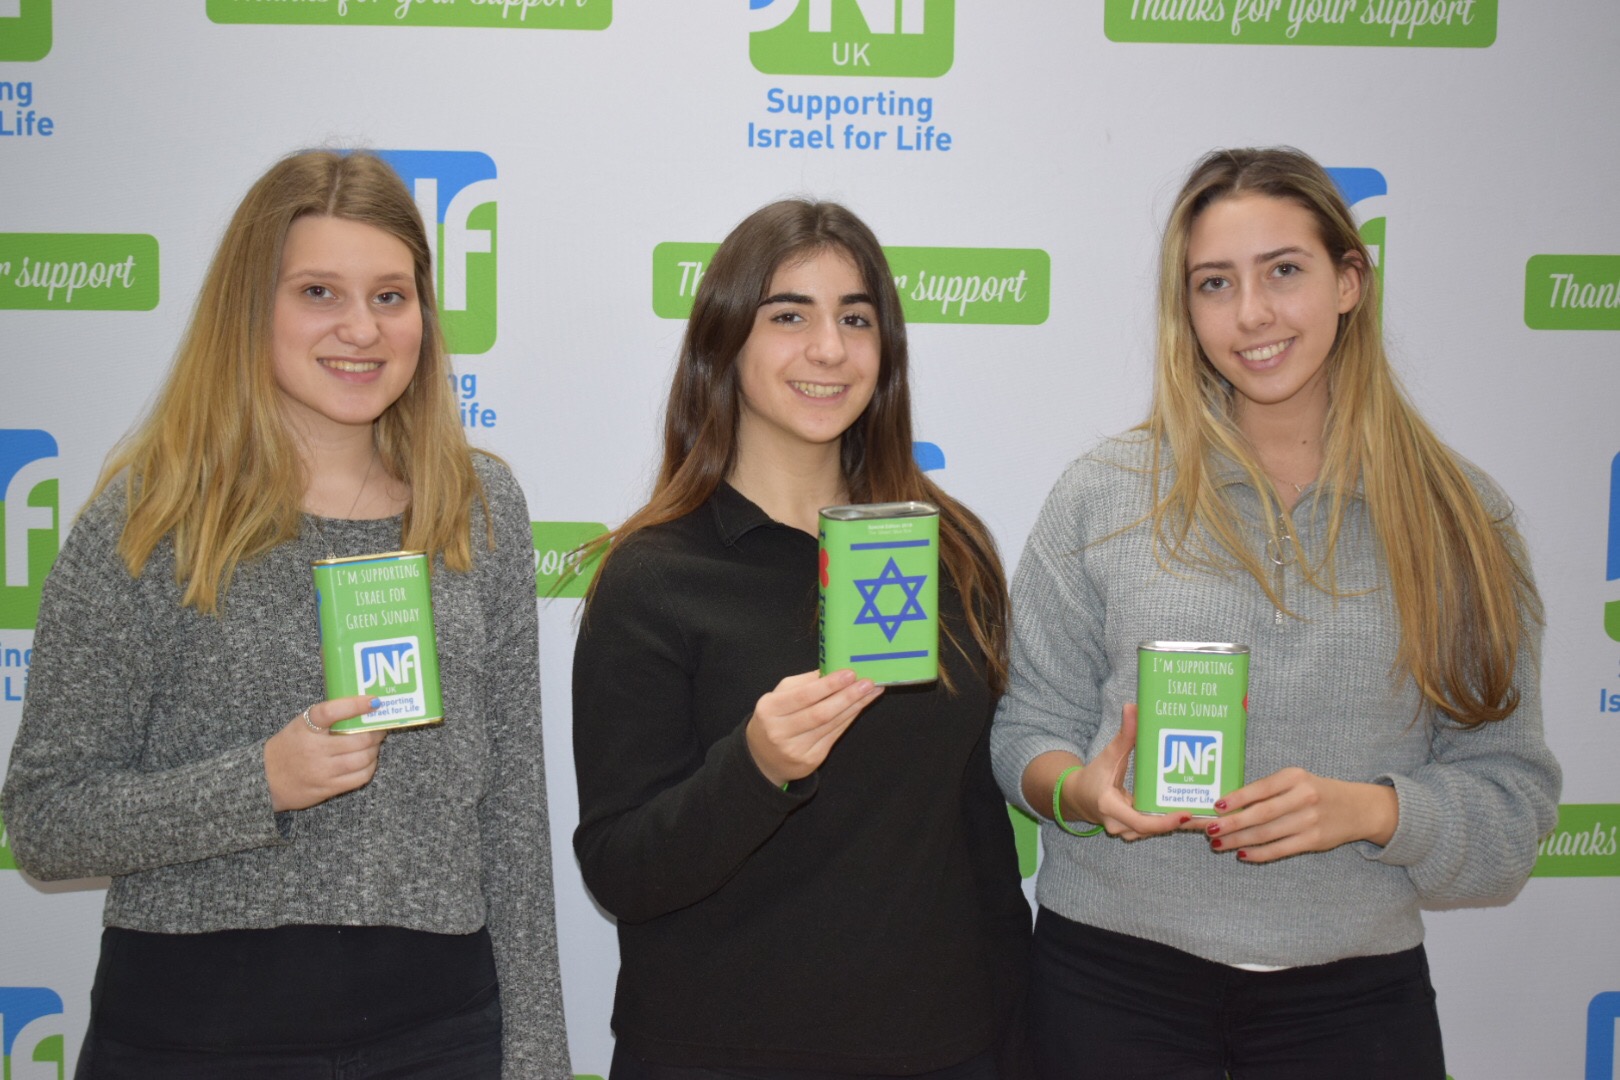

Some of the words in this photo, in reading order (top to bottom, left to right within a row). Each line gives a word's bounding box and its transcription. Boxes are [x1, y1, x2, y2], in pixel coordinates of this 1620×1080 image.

[1285, 0, 1356, 39] your
[1359, 0, 1476, 40] support
[832, 42, 871, 66] UK
[766, 87, 933, 123] Supporting
[748, 122, 835, 149] Israel
[843, 124, 888, 151] for
[897, 125, 953, 151] Life
[15, 255, 136, 303] support
[911, 269, 1028, 317] support
[1549, 273, 1620, 309] Than
[461, 402, 497, 428] ife
[337, 569, 358, 586] I'M
[360, 564, 420, 584] SUPPORTING
[355, 590, 386, 606] ISRAEL
[390, 587, 407, 601] FOR
[346, 612, 378, 630] GREEN
[381, 608, 420, 626] SUNDAY
[1153, 657, 1173, 674] I'M
[1176, 659, 1234, 676] SUPPORTING
[1167, 679, 1197, 696] ISRAEL
[1201, 682, 1218, 696] FOR
[380, 697, 414, 708] pporting
[391, 706, 403, 714] for
[404, 704, 420, 713] Life
[1155, 699, 1187, 717] GREEN
[1190, 701, 1229, 718] SUNDAY
[1162, 794, 1185, 802] Israel
[1199, 796, 1215, 804] Life
[1167, 786, 1210, 796] Supporting
[1538, 822, 1617, 856] hanks
